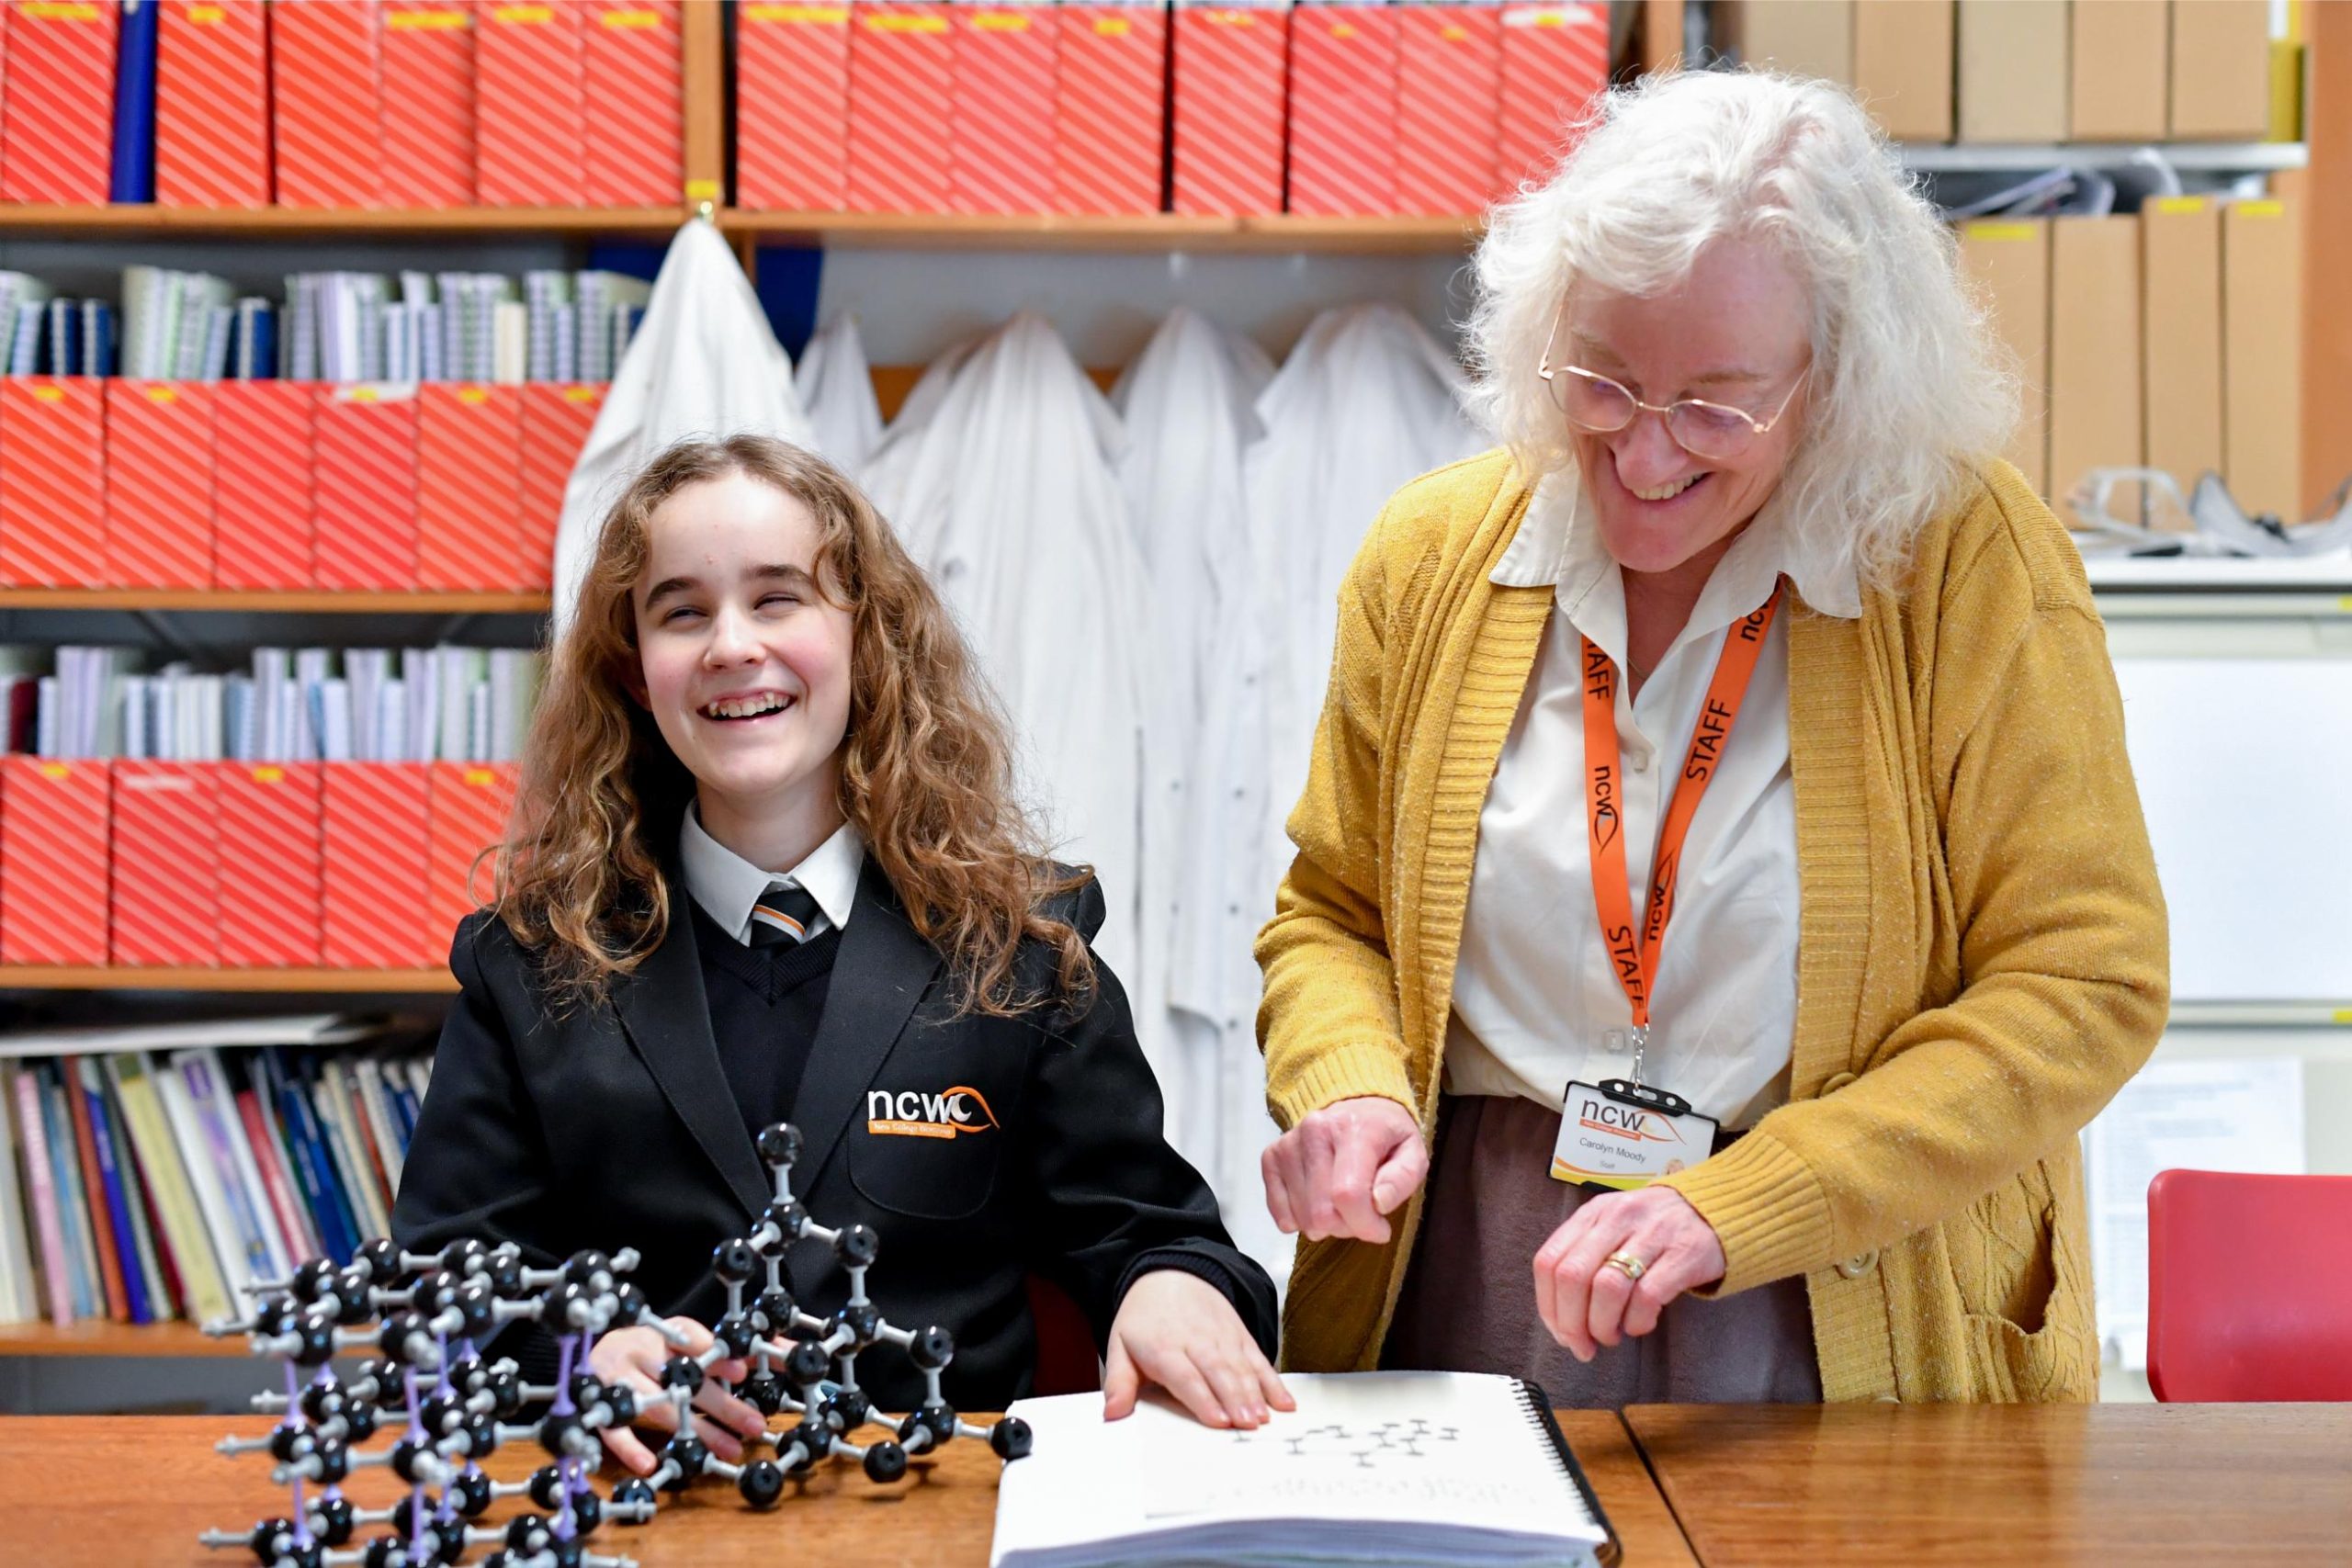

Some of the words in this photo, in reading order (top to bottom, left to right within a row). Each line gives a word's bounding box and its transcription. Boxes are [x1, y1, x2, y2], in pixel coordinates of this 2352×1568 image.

[1686, 700, 1732, 783] STAFF
[1594, 766, 1612, 817] ncw
[1648, 886, 1666, 941] ncw
[1608, 926, 1645, 1009] STAFF
[1581, 1100, 1645, 1131] ncw
[1579, 1137, 1614, 1154] Carolyn
[1616, 1147, 1646, 1165] Moody
